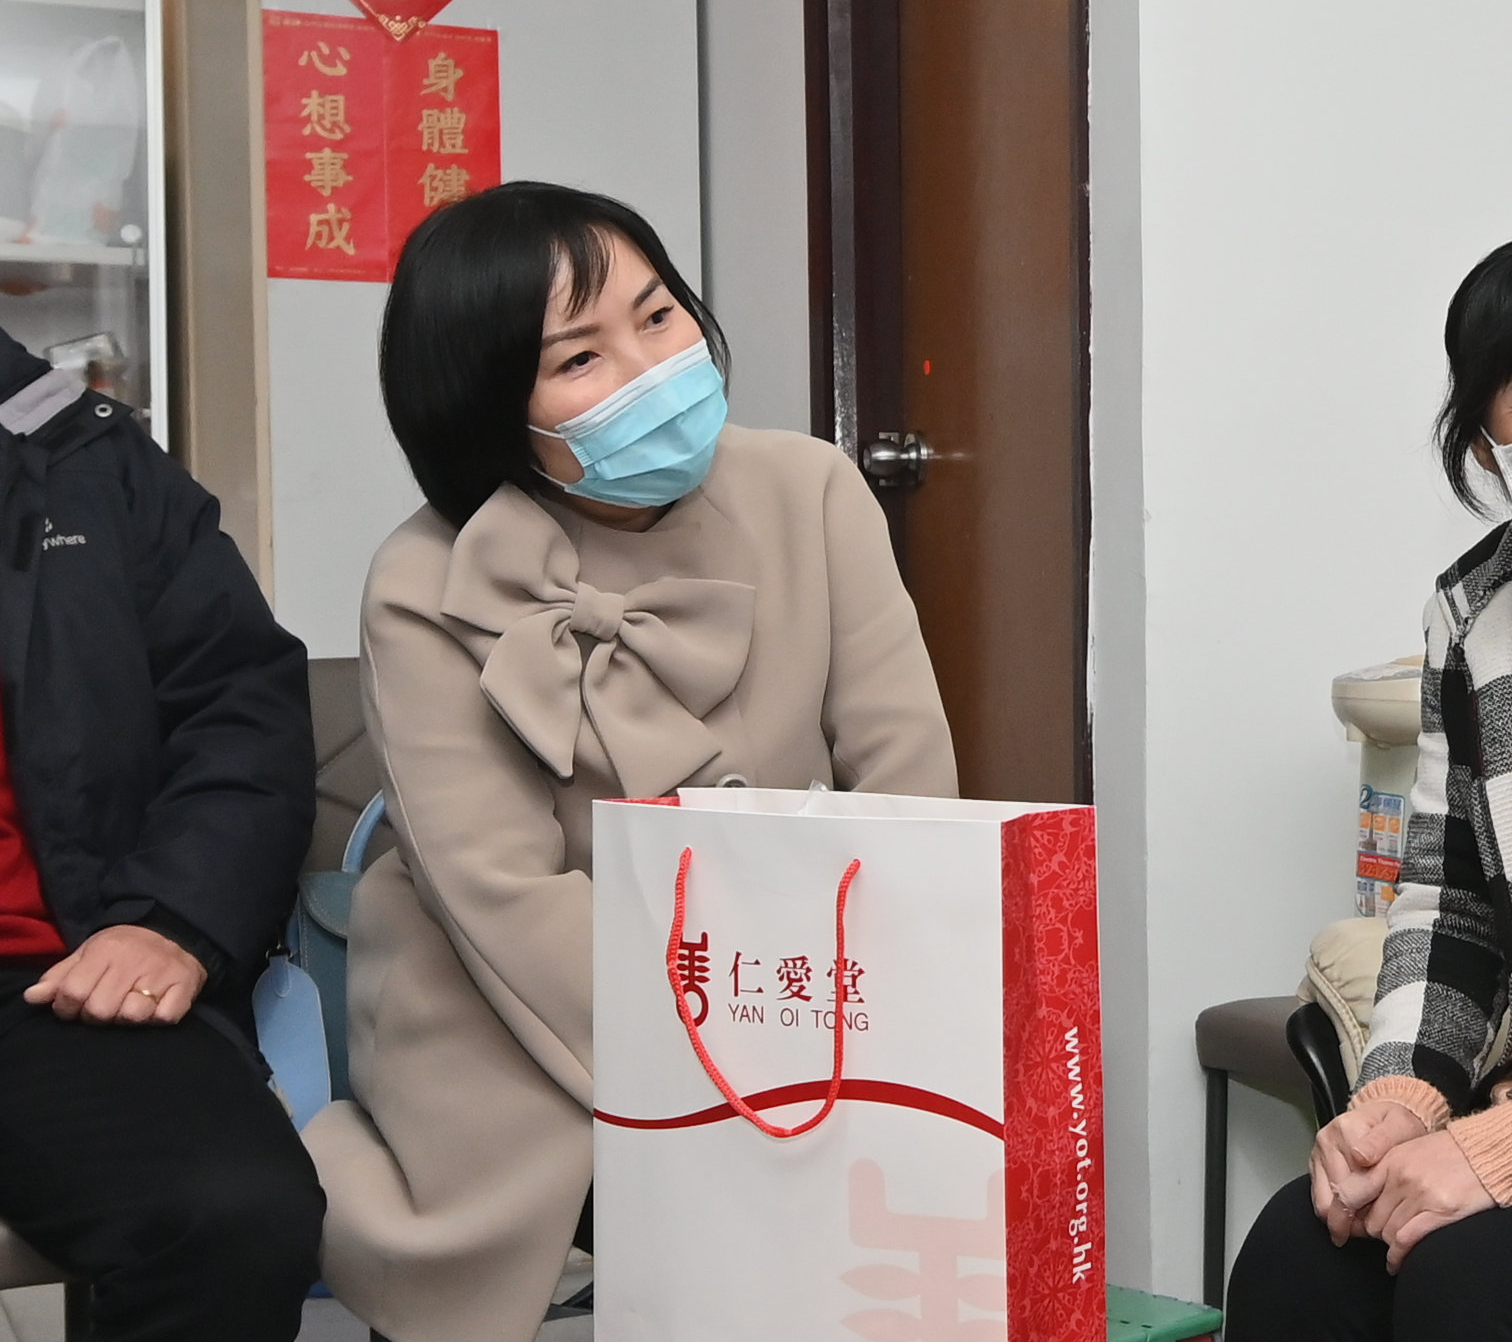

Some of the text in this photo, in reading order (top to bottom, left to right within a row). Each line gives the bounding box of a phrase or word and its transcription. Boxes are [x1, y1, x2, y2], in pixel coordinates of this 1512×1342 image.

[298, 41, 356, 255] 心想事成
[727, 1003, 869, 1031] YAN OI TONG
[728, 951, 866, 1004] 仁愛堂
[1064, 1026, 1092, 1284] www.yot.org.hk
